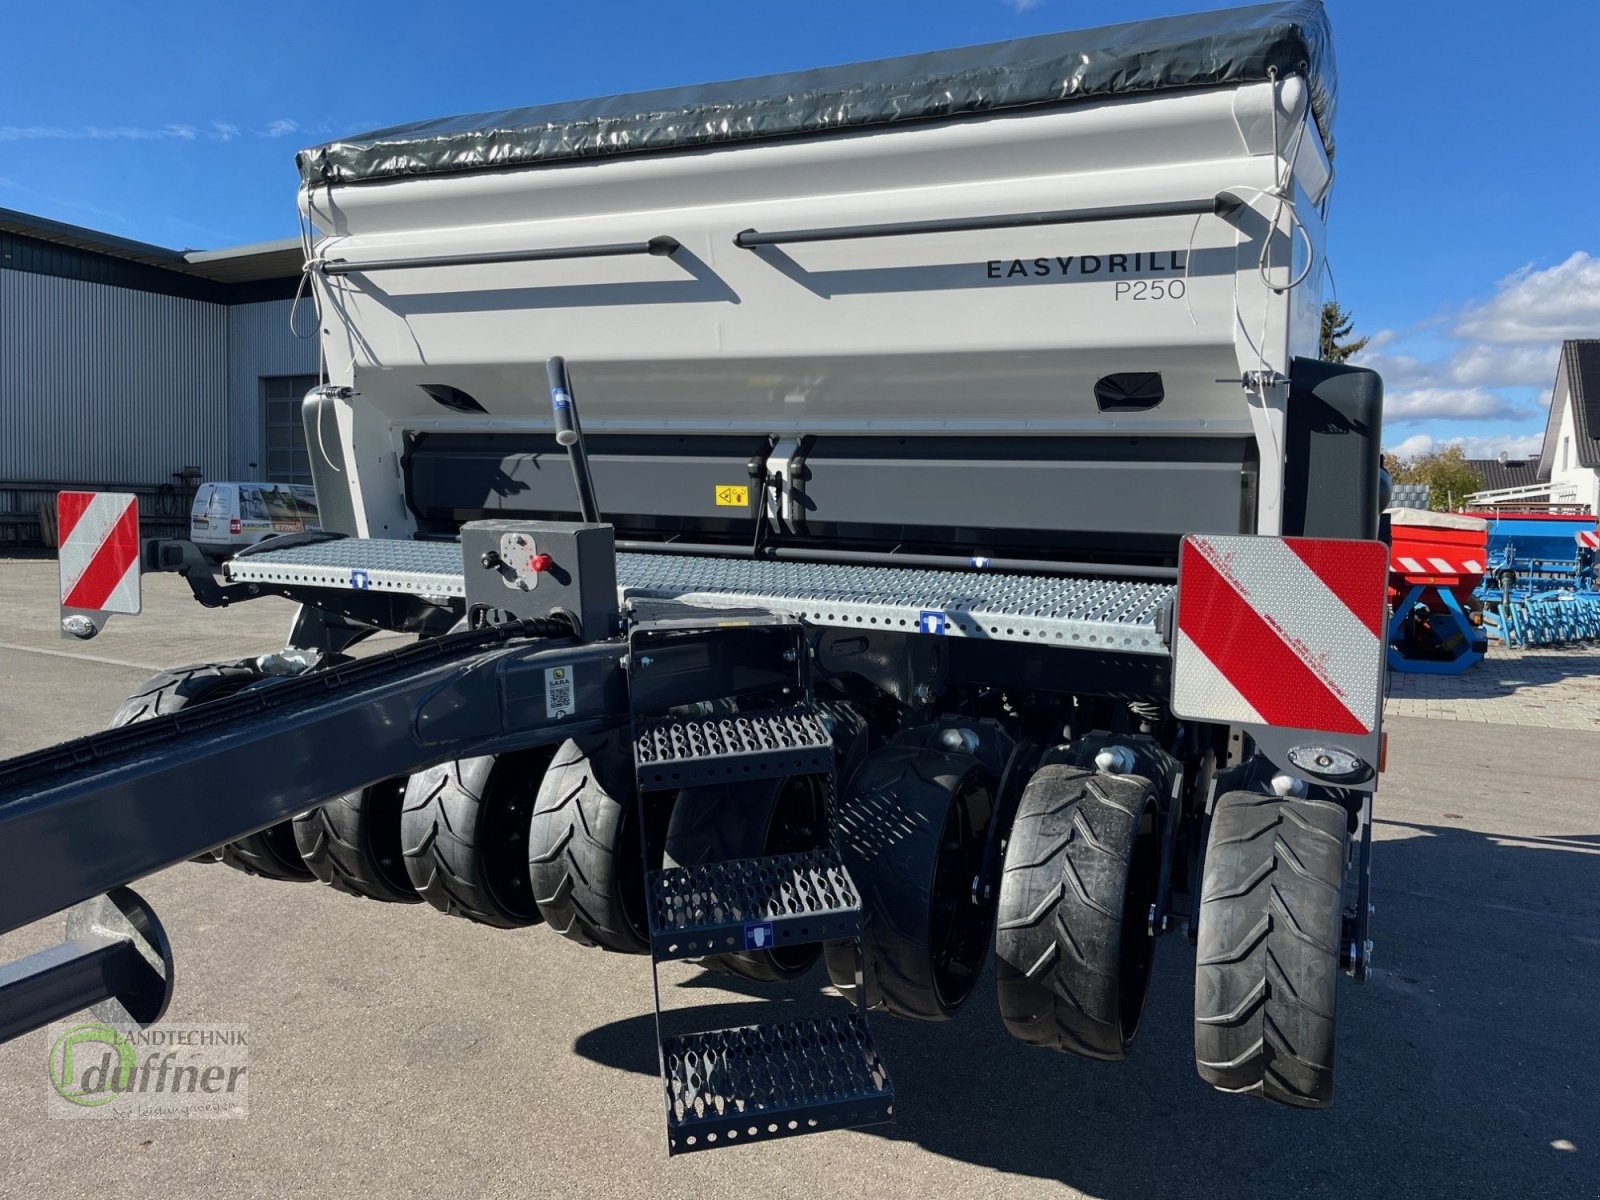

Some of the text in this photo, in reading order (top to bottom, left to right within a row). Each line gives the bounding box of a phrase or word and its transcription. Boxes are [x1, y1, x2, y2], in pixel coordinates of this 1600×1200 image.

[987, 251, 1186, 278] EASYDRILL
[1115, 280, 1185, 301] P250
[549, 679, 570, 687] SARA
